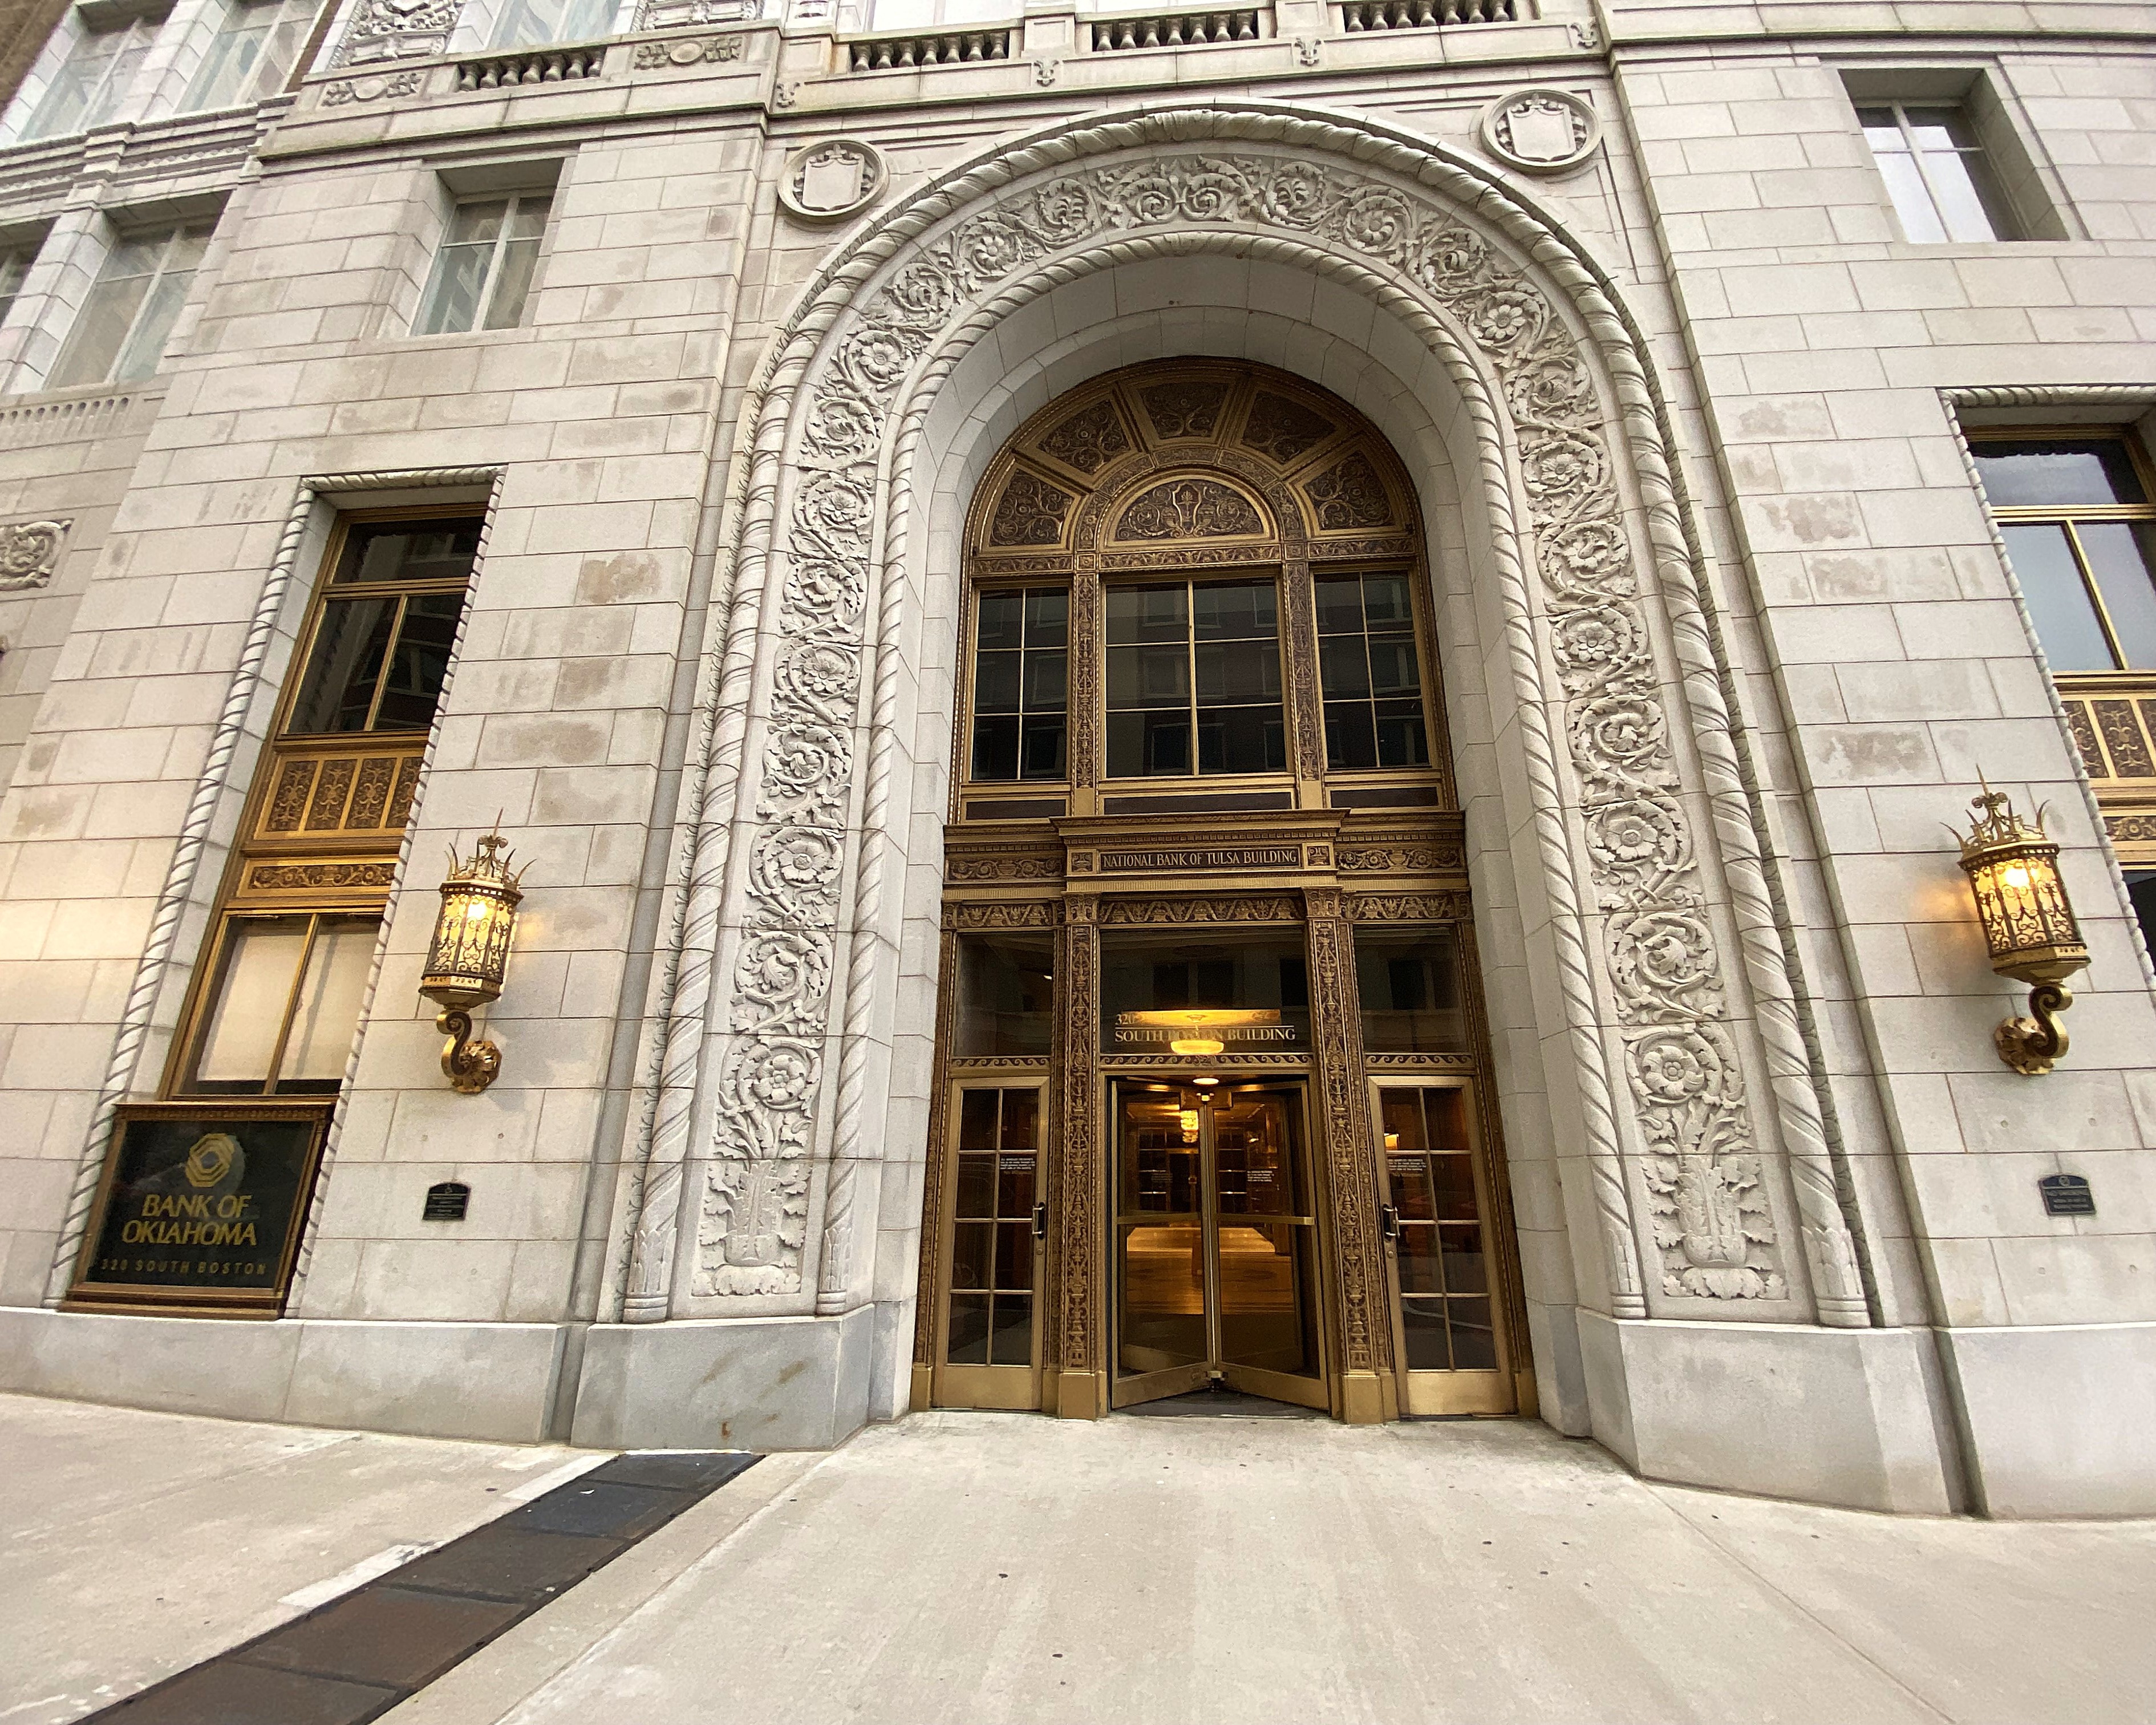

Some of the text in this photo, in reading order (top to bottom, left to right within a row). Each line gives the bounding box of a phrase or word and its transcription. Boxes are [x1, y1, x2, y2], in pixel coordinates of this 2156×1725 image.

[1104, 850, 1296, 867] NATIONAL BANK OF TULSA BUILDING
[1115, 1014, 1135, 1025] 320
[1115, 1030, 1164, 1042] SOUTH
[1227, 1028, 1296, 1040] BUILDING
[141, 1194, 253, 1218] BANK OF
[121, 1220, 256, 1246] OKLAHOMA
[135, 1259, 190, 1274] SOUTH
[197, 1261, 266, 1275] BOSTON
